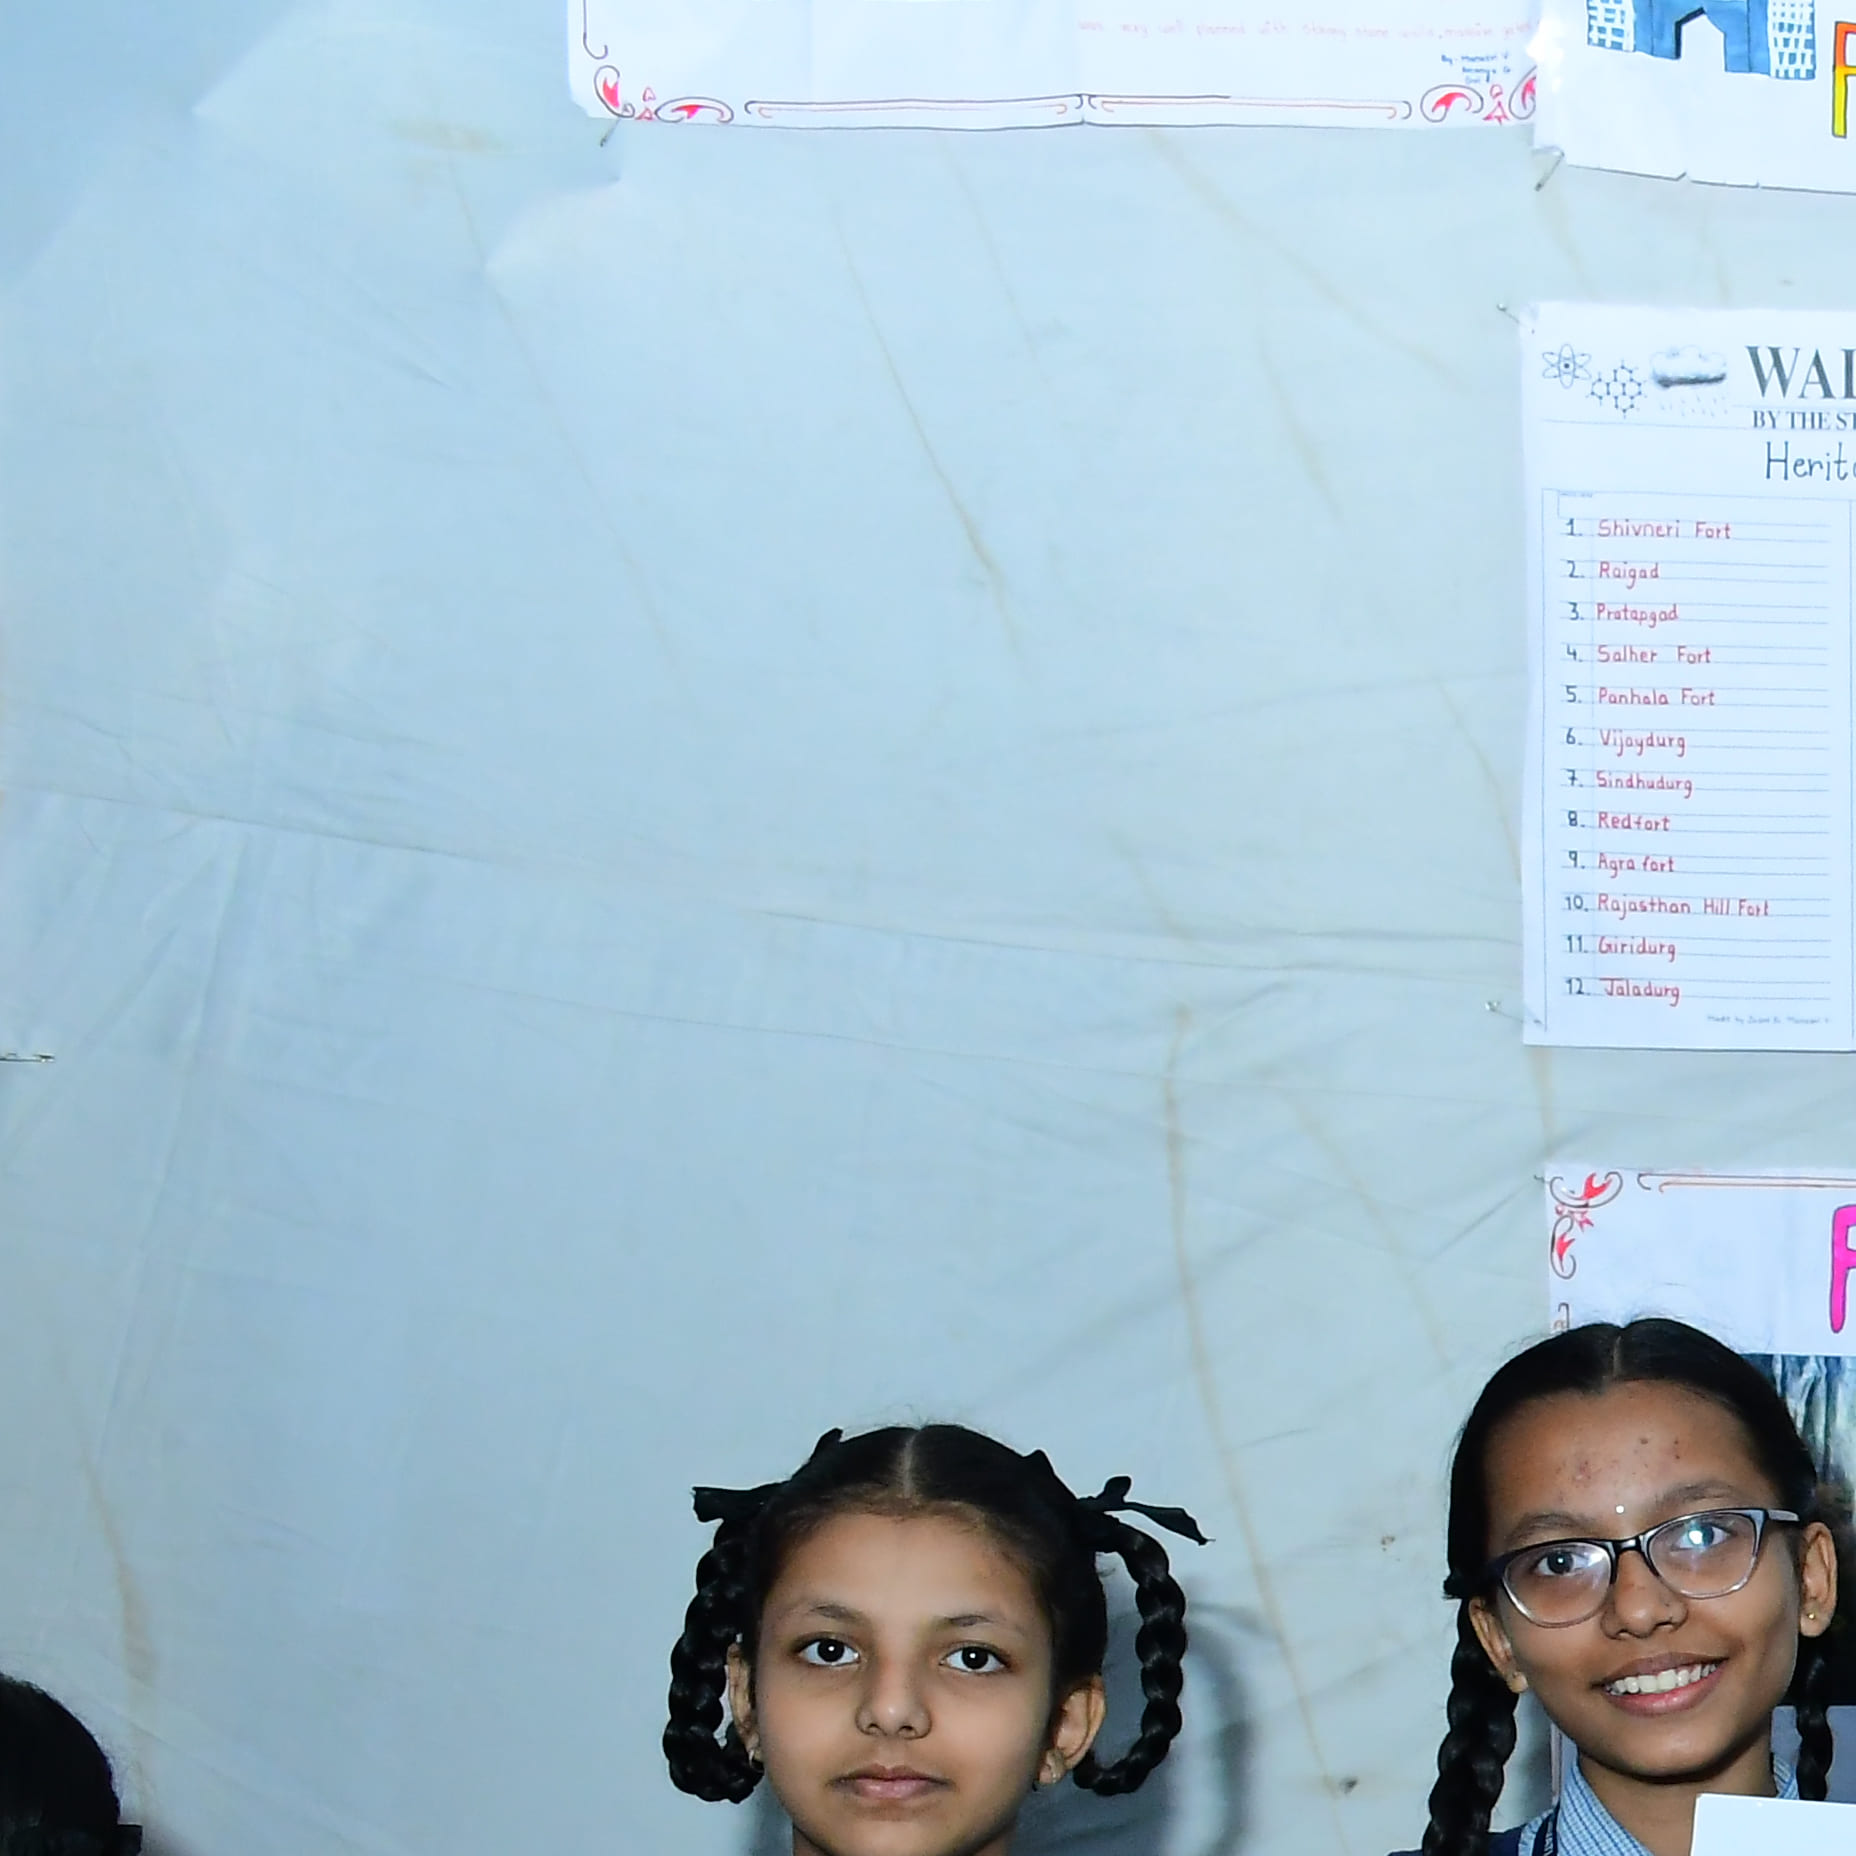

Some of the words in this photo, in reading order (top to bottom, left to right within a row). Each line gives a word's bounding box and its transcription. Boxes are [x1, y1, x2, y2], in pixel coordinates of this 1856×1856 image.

[1753, 410, 1780, 429] BY
[1788, 411, 1830, 430] THE
[1598, 519, 1680, 538] Shivneri
[1695, 522, 1731, 539] Fort
[1599, 562, 1659, 589] Raigad
[1597, 603, 1678, 628] Pratapgad
[1598, 645, 1657, 663] Salher
[1677, 646, 1711, 664] Fort
[1599, 688, 1669, 705] Panhala
[1681, 688, 1715, 706] Fort
[1600, 729, 1686, 757] Vijaydurg
[1597, 771, 1693, 798] Sindhudurg
[1598, 852, 1635, 878] Agra
[1642, 856, 1675, 872] fort
[1598, 894, 1691, 920] Rajasthan
[1704, 898, 1730, 915] Hill
[1738, 899, 1769, 916] Fort
[1599, 936, 1676, 963] Giridurg
[1599, 977, 1680, 1007] Jaladurg
